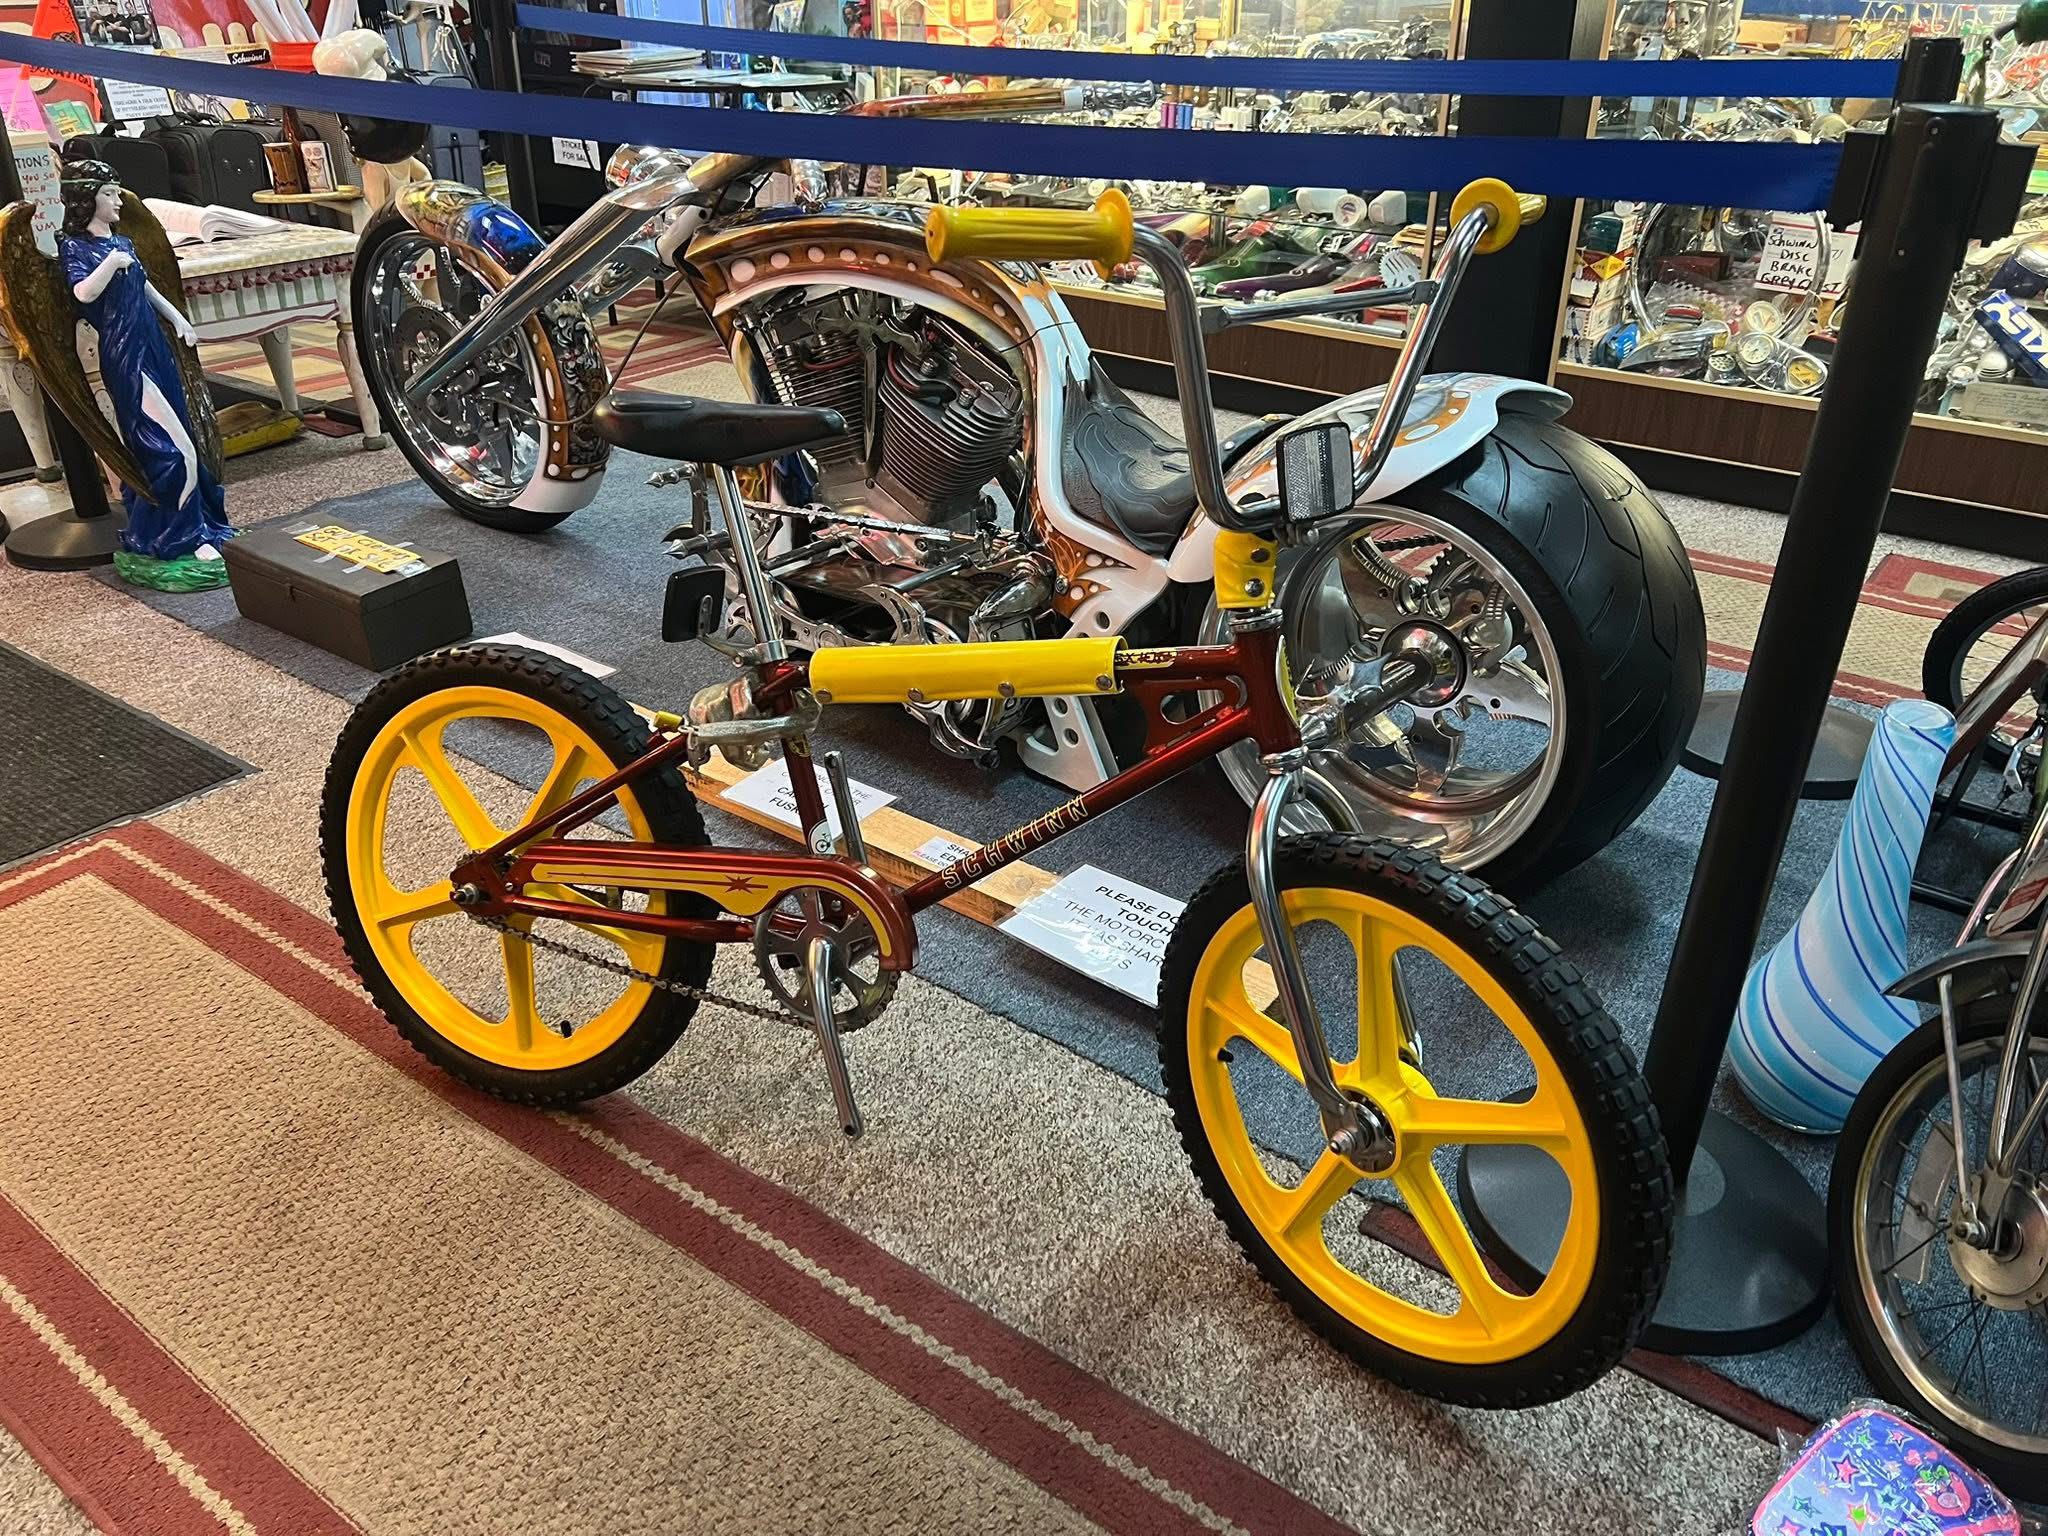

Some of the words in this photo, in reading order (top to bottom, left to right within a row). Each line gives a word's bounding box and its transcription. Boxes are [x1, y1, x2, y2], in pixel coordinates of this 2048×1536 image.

[15, 154, 51, 169] TIONS
[942, 794, 1089, 888] SCHWINN
[947, 843, 970, 857] SHA
[1095, 885, 1157, 914] PLEASE
[1064, 900, 1096, 918] THE
[1094, 914, 1165, 949] MOTORC
[1117, 908, 1176, 937] TOUCH
[1117, 940, 1166, 967] SHAR
